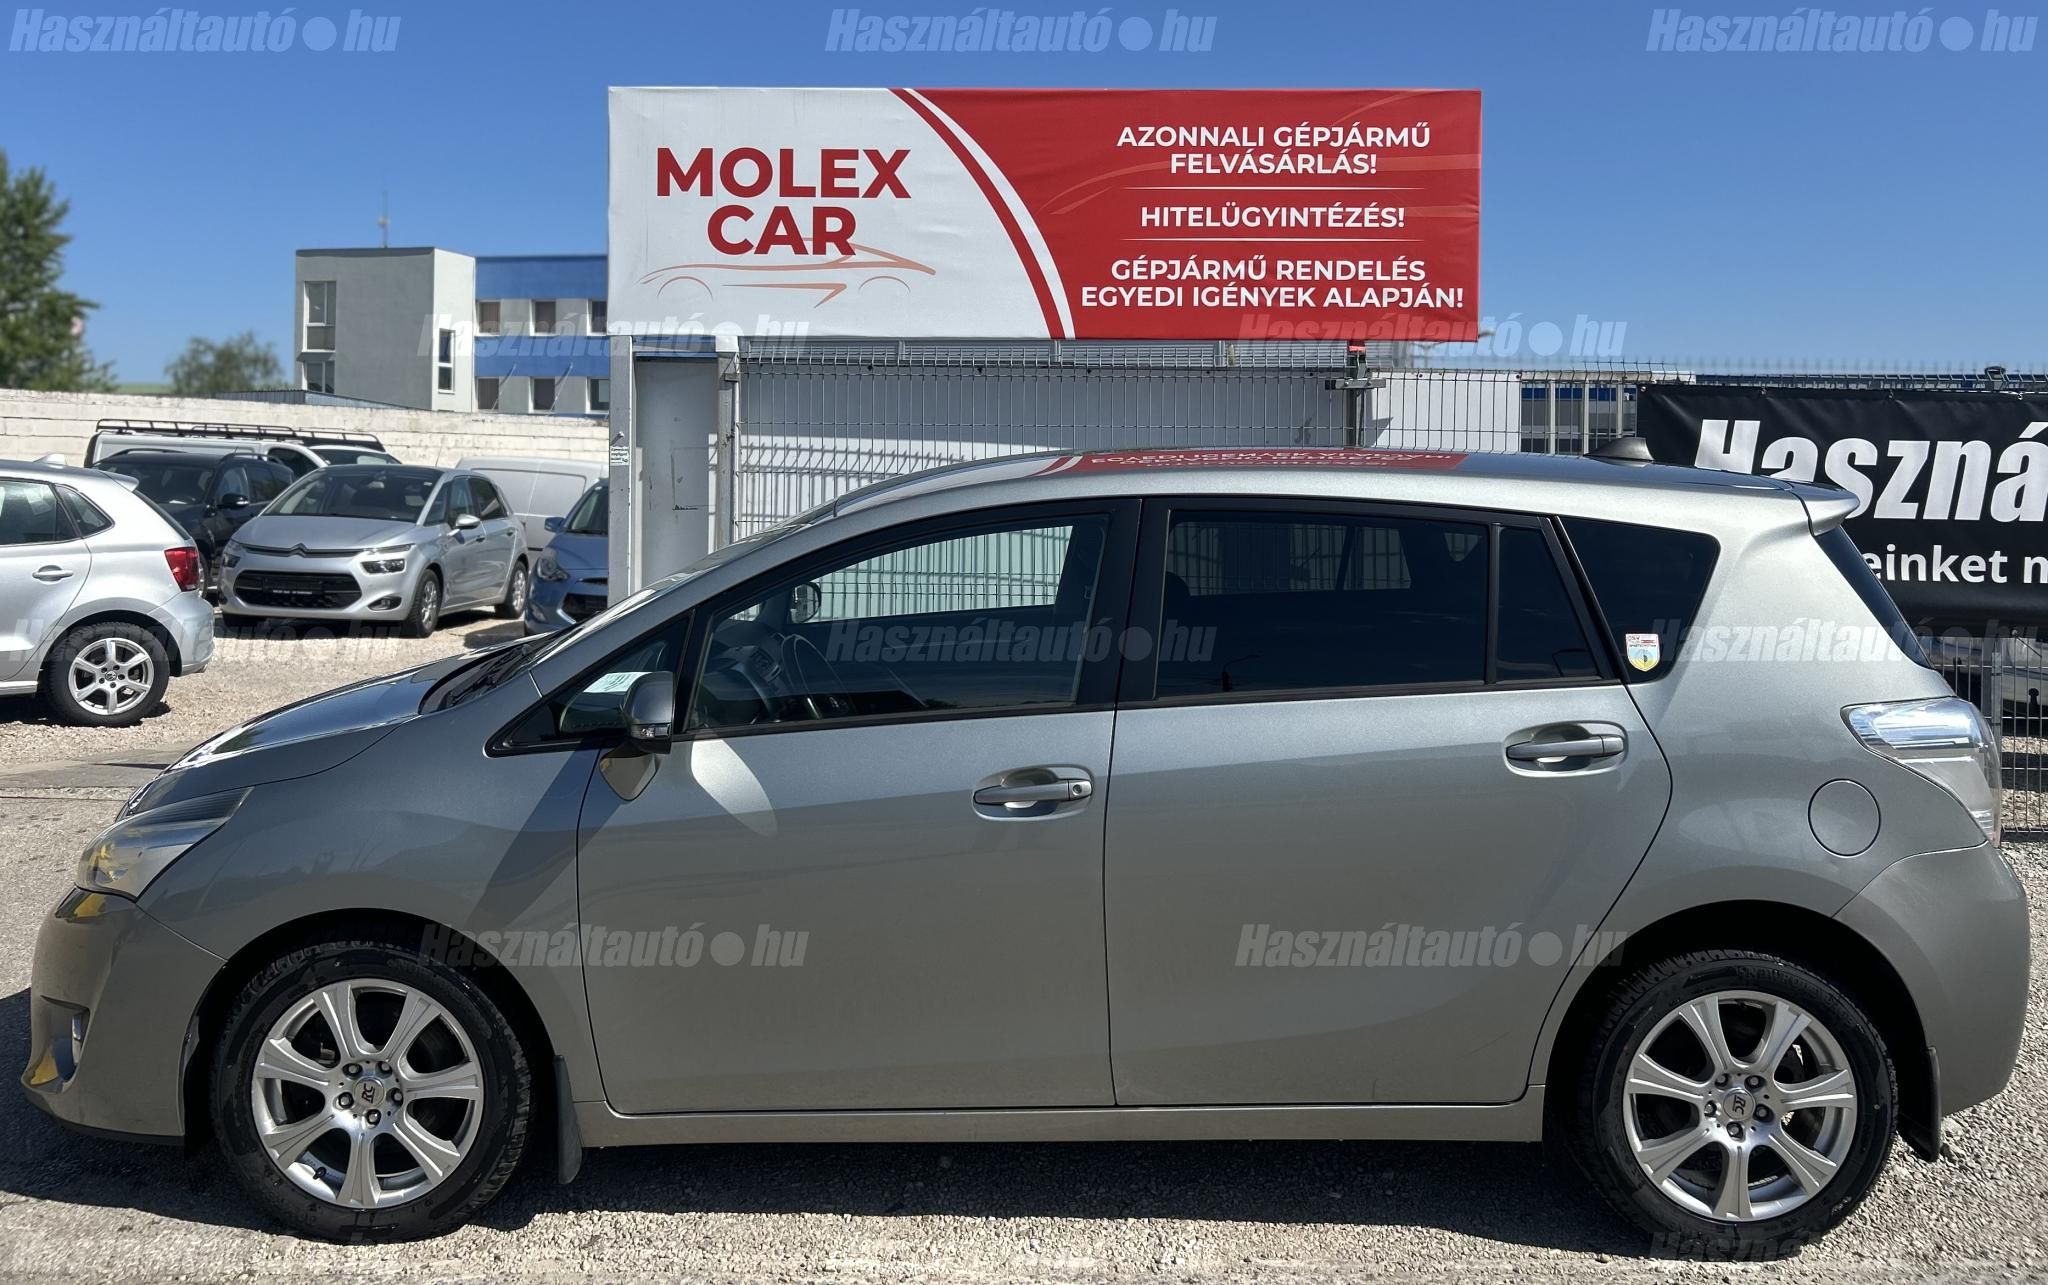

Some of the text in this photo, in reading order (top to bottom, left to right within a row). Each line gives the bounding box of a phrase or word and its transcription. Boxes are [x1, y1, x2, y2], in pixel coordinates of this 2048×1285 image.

[1117, 122, 1430, 147] AZONNALI GÉPJÁRMŰ
[657, 147, 911, 198] MOLEX
[1170, 150, 1377, 174] FELVÁSÁRLÁS!
[1141, 202, 1405, 228] HITELÜGYINTÉZÉS!
[707, 204, 857, 256] CAR
[1111, 255, 1426, 281] GÉPJÁRMŰ RENDELÉS
[1081, 282, 1463, 308] EGYEDI IGÉNYEK ALAPJÁN!
